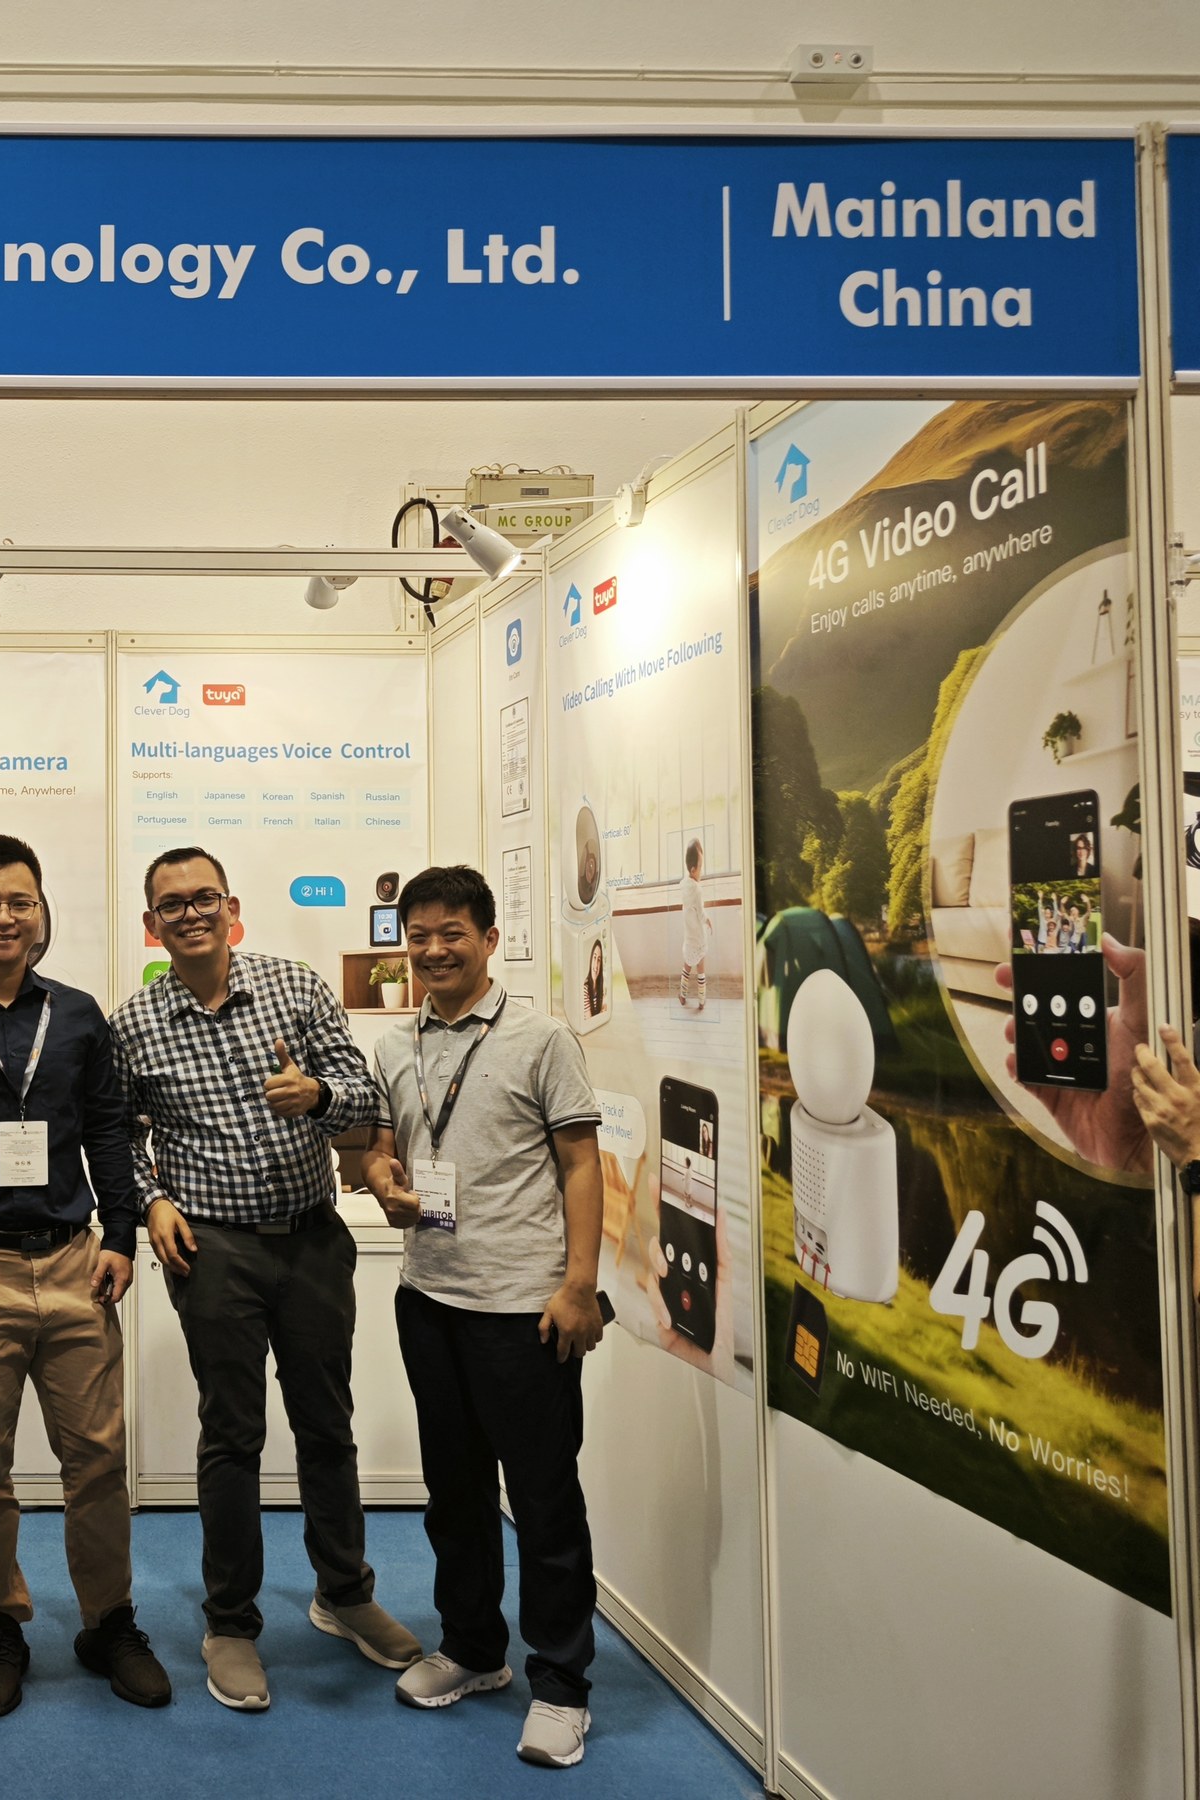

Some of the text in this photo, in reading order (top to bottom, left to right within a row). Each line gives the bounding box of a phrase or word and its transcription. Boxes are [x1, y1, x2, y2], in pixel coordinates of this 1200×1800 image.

[772, 180, 1096, 239] Mainland
[281, 227, 419, 294] Co.,
[447, 225, 580, 285] Ltd.
[839, 268, 1032, 328] China
[498, 515, 573, 527] MC GROUP
[768, 497, 820, 535] Clever Dog
[808, 441, 1048, 591] 4G Video Call
[811, 523, 1053, 634] Enjoy calls anytime, anywhere
[594, 586, 616, 606] tuya
[558, 624, 587, 648] Clever Dog
[562, 632, 722, 712] Video Calling With Move Following
[206, 687, 241, 703] tuya
[134, 705, 190, 719] Clever Dog
[1180, 711, 1191, 720] sy
[131, 742, 411, 762] Multi-languages Voice Control
[132, 770, 173, 780] Supports:
[21, 785, 76, 797] Anywhere!
[146, 791, 178, 801] English
[204, 791, 246, 802] Japanese
[262, 793, 294, 802] Korean
[310, 791, 345, 802] Spanish
[365, 792, 400, 802] Russian
[137, 815, 187, 827] Portuguese
[208, 816, 242, 826] German
[263, 816, 293, 826] French
[314, 816, 341, 826] Italian
[365, 817, 401, 826] Chinese
[315, 886, 326, 896] Hi
[602, 1102, 617, 1117] Track
[617, 1105, 625, 1118] of
[615, 1125, 633, 1140] Move!
[422, 1208, 453, 1220] HIBITOR
[929, 1210, 1060, 1359] 4G
[836, 1349, 1130, 1502] No WIFI Needed, No Worries!
